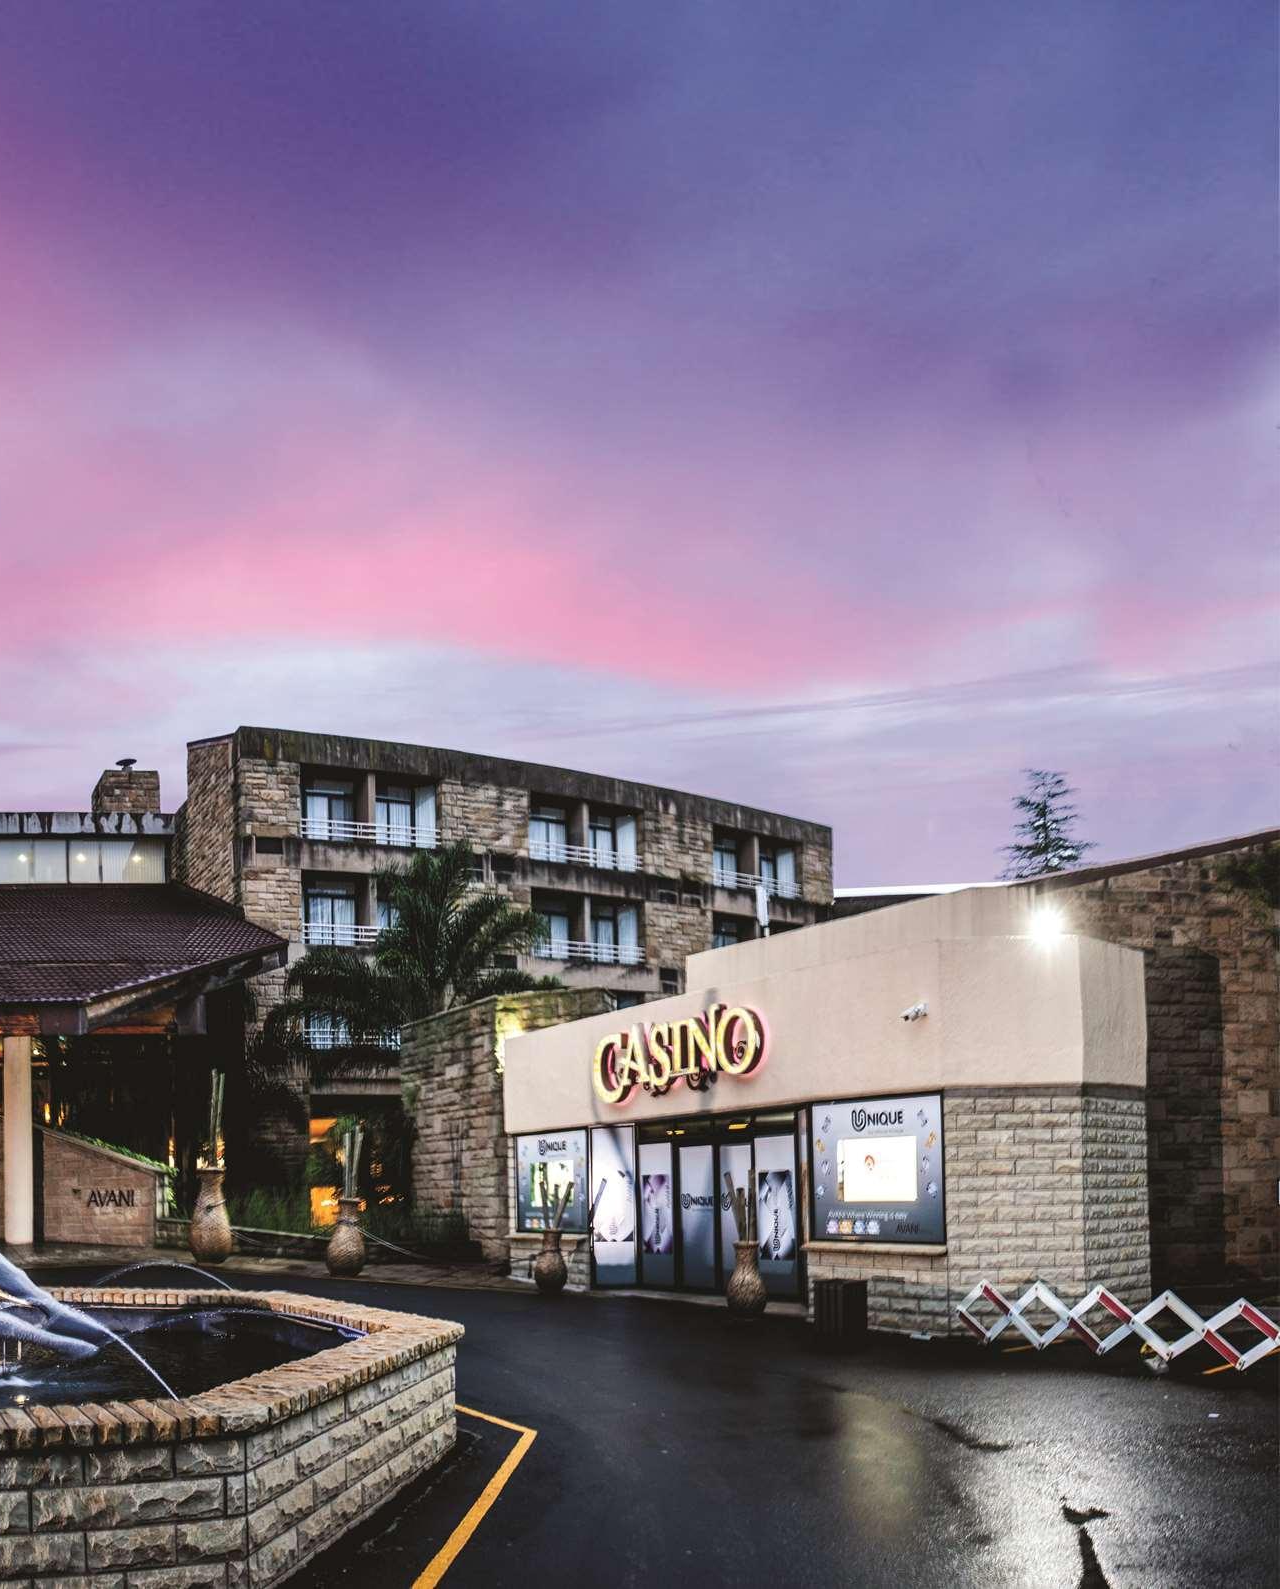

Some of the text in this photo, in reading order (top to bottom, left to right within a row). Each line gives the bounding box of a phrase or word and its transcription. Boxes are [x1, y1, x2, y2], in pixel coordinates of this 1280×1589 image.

[593, 1004, 763, 1103] CASINO
[851, 1109, 904, 1132] UNIQUE
[87, 1189, 135, 1207] AVANI
